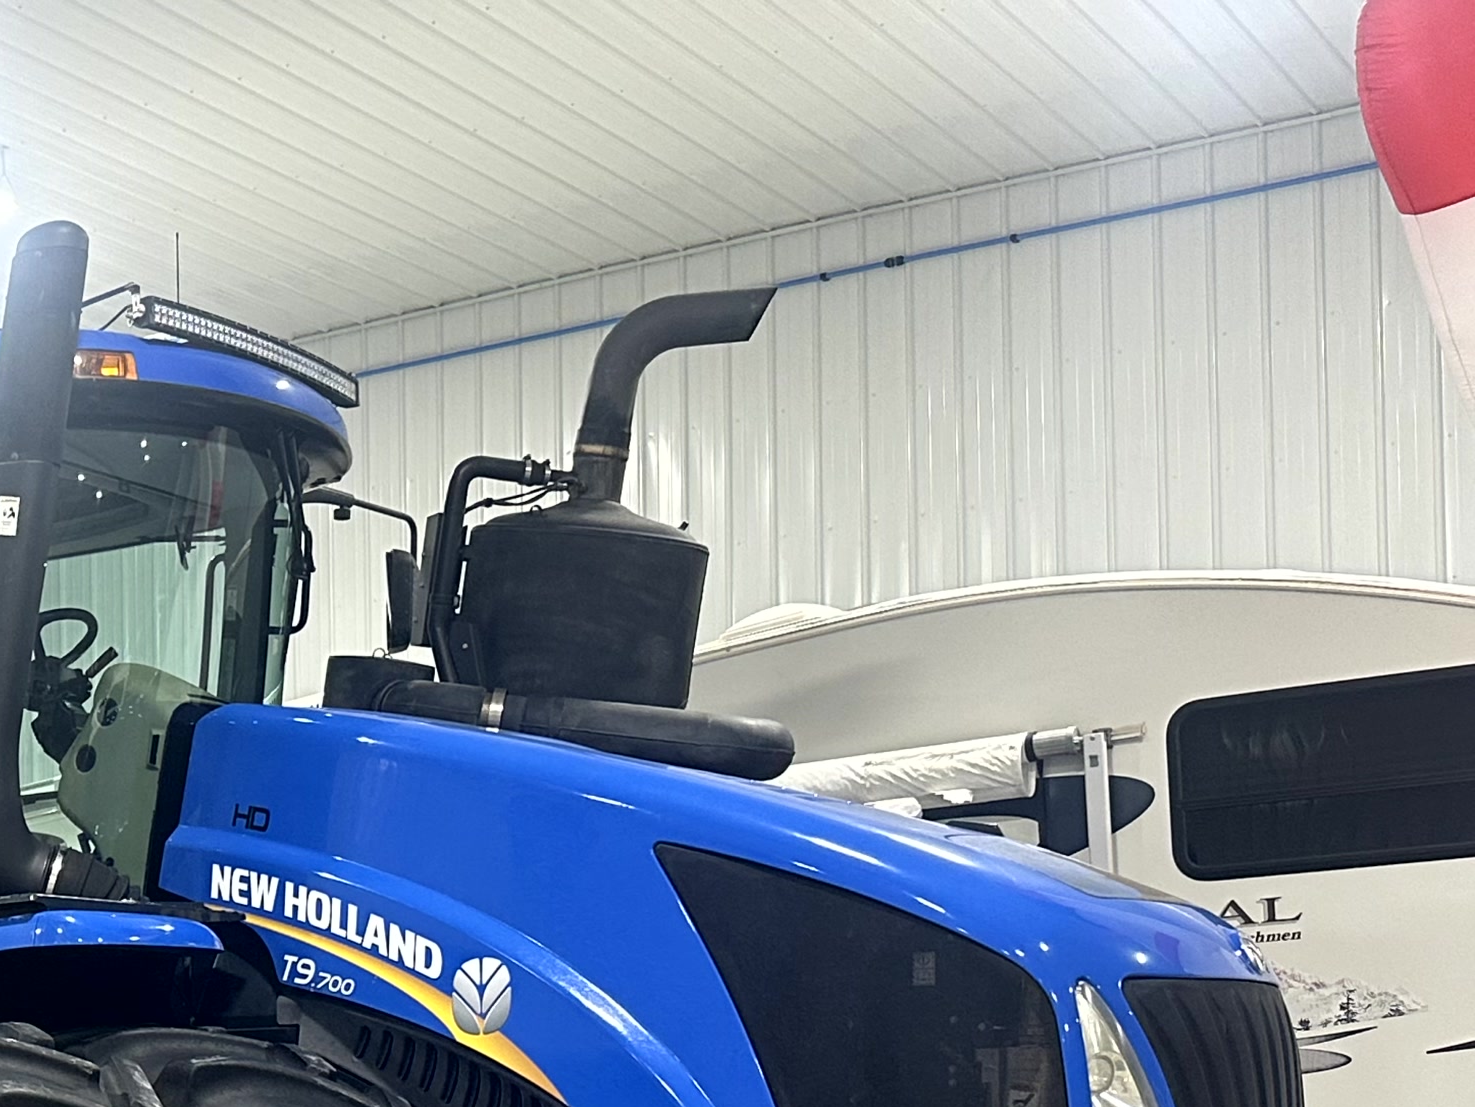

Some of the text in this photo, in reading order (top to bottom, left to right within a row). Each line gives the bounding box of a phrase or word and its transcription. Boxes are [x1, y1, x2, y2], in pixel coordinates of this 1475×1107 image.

[232, 803, 270, 832] HD
[210, 863, 443, 980] NEW HOLLAND
[1250, 931, 1302, 944] hmen
[281, 954, 355, 995] T9.700
